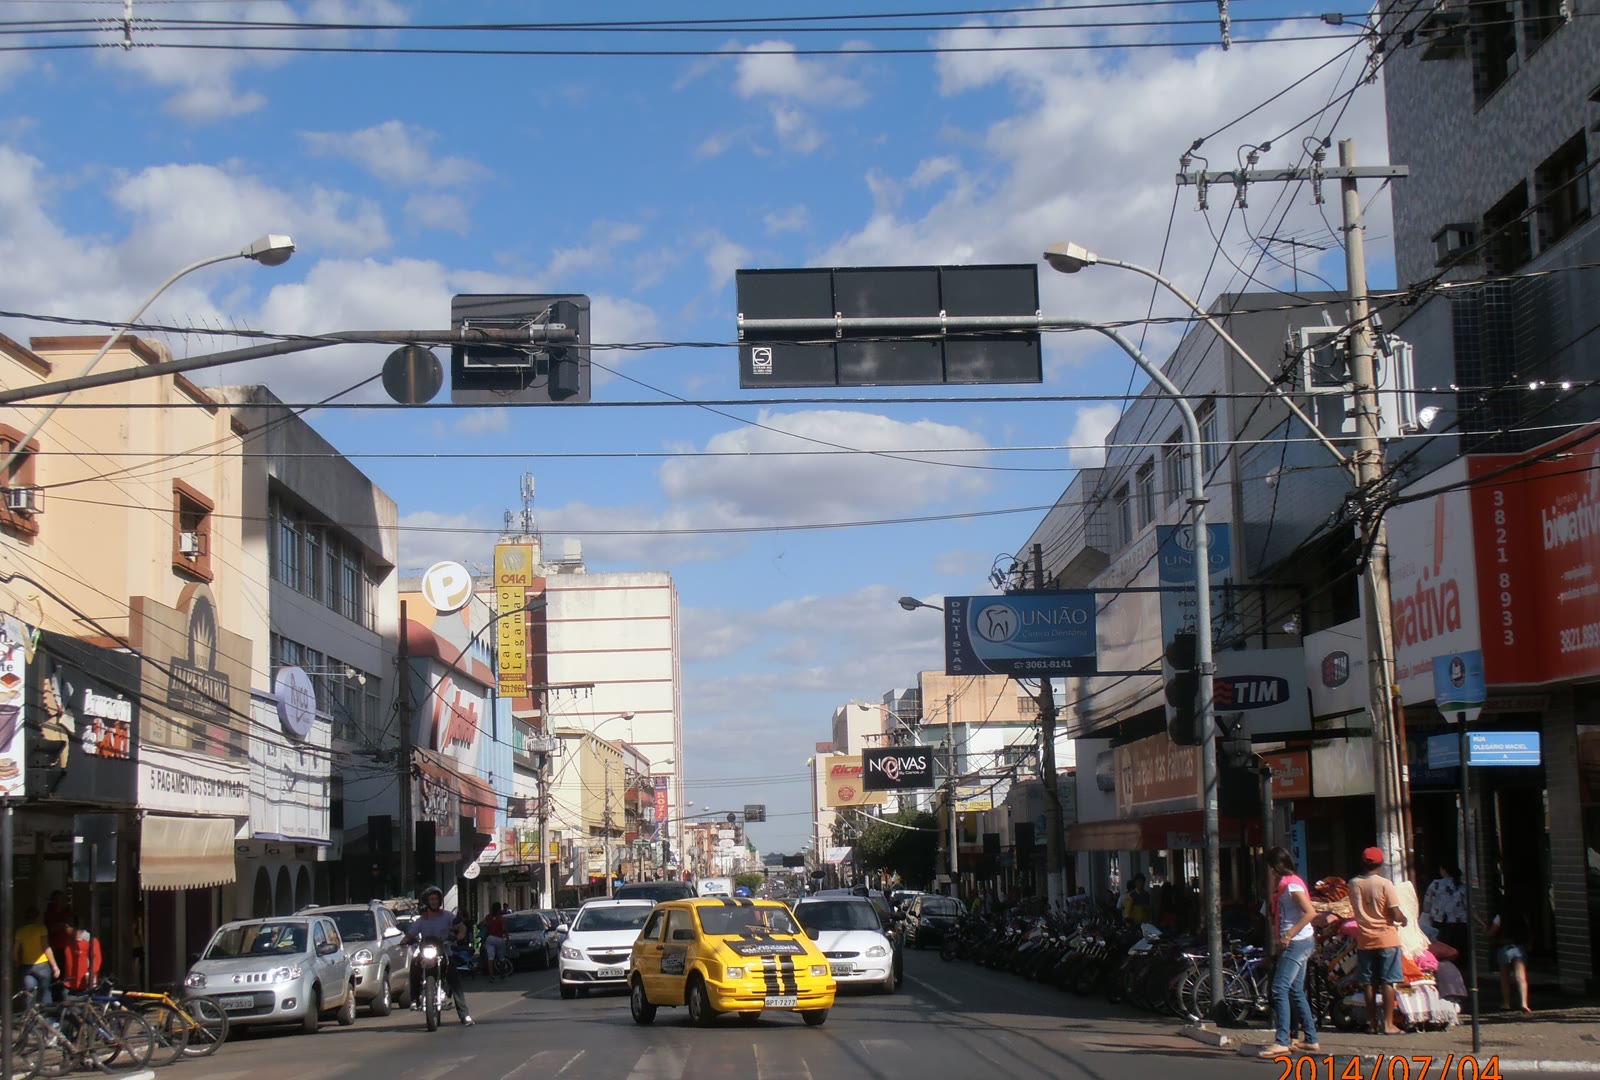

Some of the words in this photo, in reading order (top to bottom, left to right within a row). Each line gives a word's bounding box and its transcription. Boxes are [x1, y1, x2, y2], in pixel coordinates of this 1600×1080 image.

[500, 592, 510, 670] Calcário
[513, 592, 525, 670] Lagamar
[1022, 606, 1087, 626] UNIÃO
[951, 601, 962, 671] DENTISTAS
[1025, 660, 1072, 669] 3061-8141
[172, 664, 229, 704] IMPERATRIZ
[1233, 680, 1279, 703] TIM
[869, 756, 926, 773] NOIVAS
[150, 769, 156, 790] 5
[157, 770, 202, 796] PAGAMENTOS
[203, 777, 216, 797] SEM
[217, 779, 245, 799] ENTRADA
